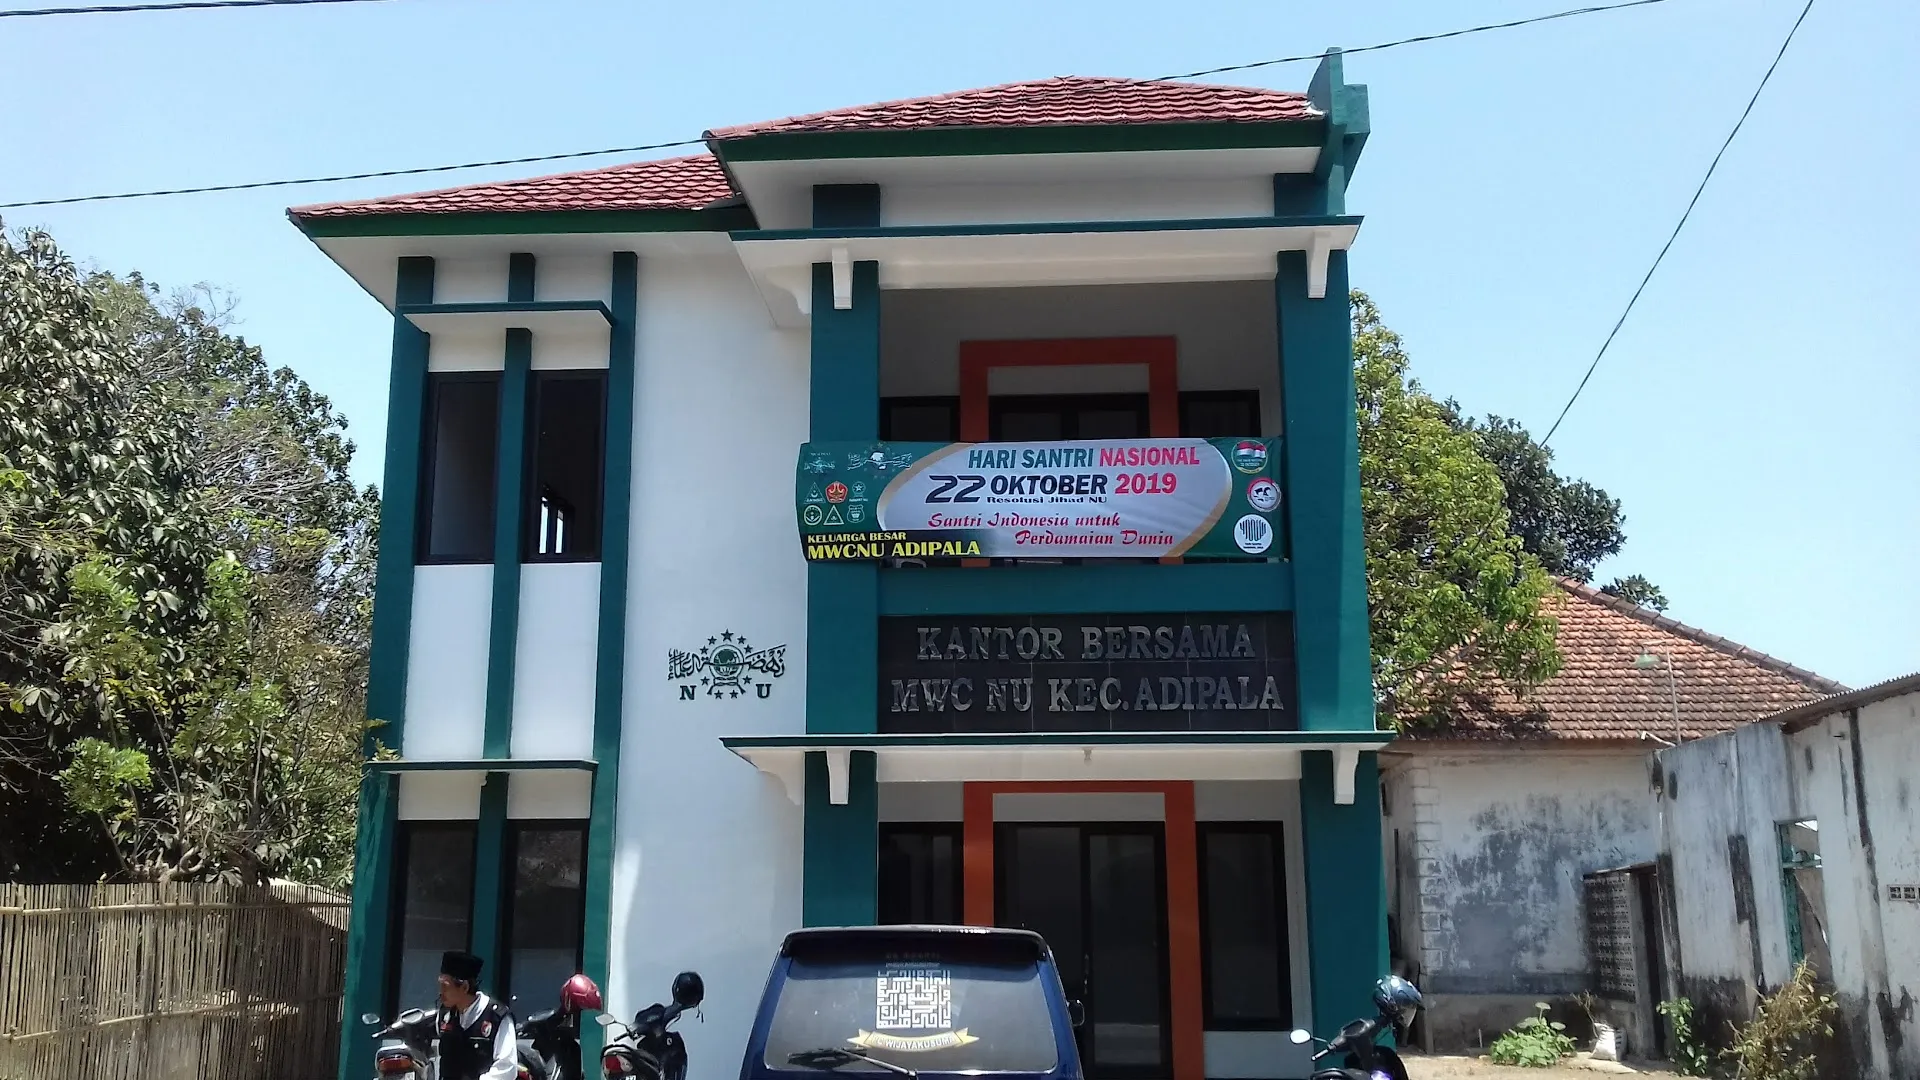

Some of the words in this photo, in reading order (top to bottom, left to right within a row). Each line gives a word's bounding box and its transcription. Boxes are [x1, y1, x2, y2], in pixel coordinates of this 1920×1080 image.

[968, 449, 1016, 469] HARI
[1021, 448, 1093, 469] SANTRI
[1099, 446, 1200, 468] NASIONAL
[925, 474, 986, 504] 22
[990, 473, 1108, 496] OKTOBER
[1114, 472, 1177, 495] 2019
[986, 496, 1043, 504] Resolusi
[1048, 496, 1084, 504] Jihad
[1089, 496, 1107, 504] NU
[928, 512, 982, 527] Santri
[987, 511, 1069, 528] Indonesia
[1075, 511, 1120, 527] untuk
[807, 532, 866, 544] KELUARGA
[869, 531, 907, 542] BESAR
[1014, 529, 1113, 545] Perdamaian
[1119, 529, 1173, 545] Dunia
[807, 543, 885, 560] MWCNU
[891, 541, 981, 557] ADIPALA
[916, 626, 1065, 660] KANTOR
[1080, 624, 1256, 660] BERSAMA
[679, 685, 697, 700] N
[755, 683, 772, 699] U
[891, 677, 973, 712] MWC
[985, 677, 1034, 712] NU
